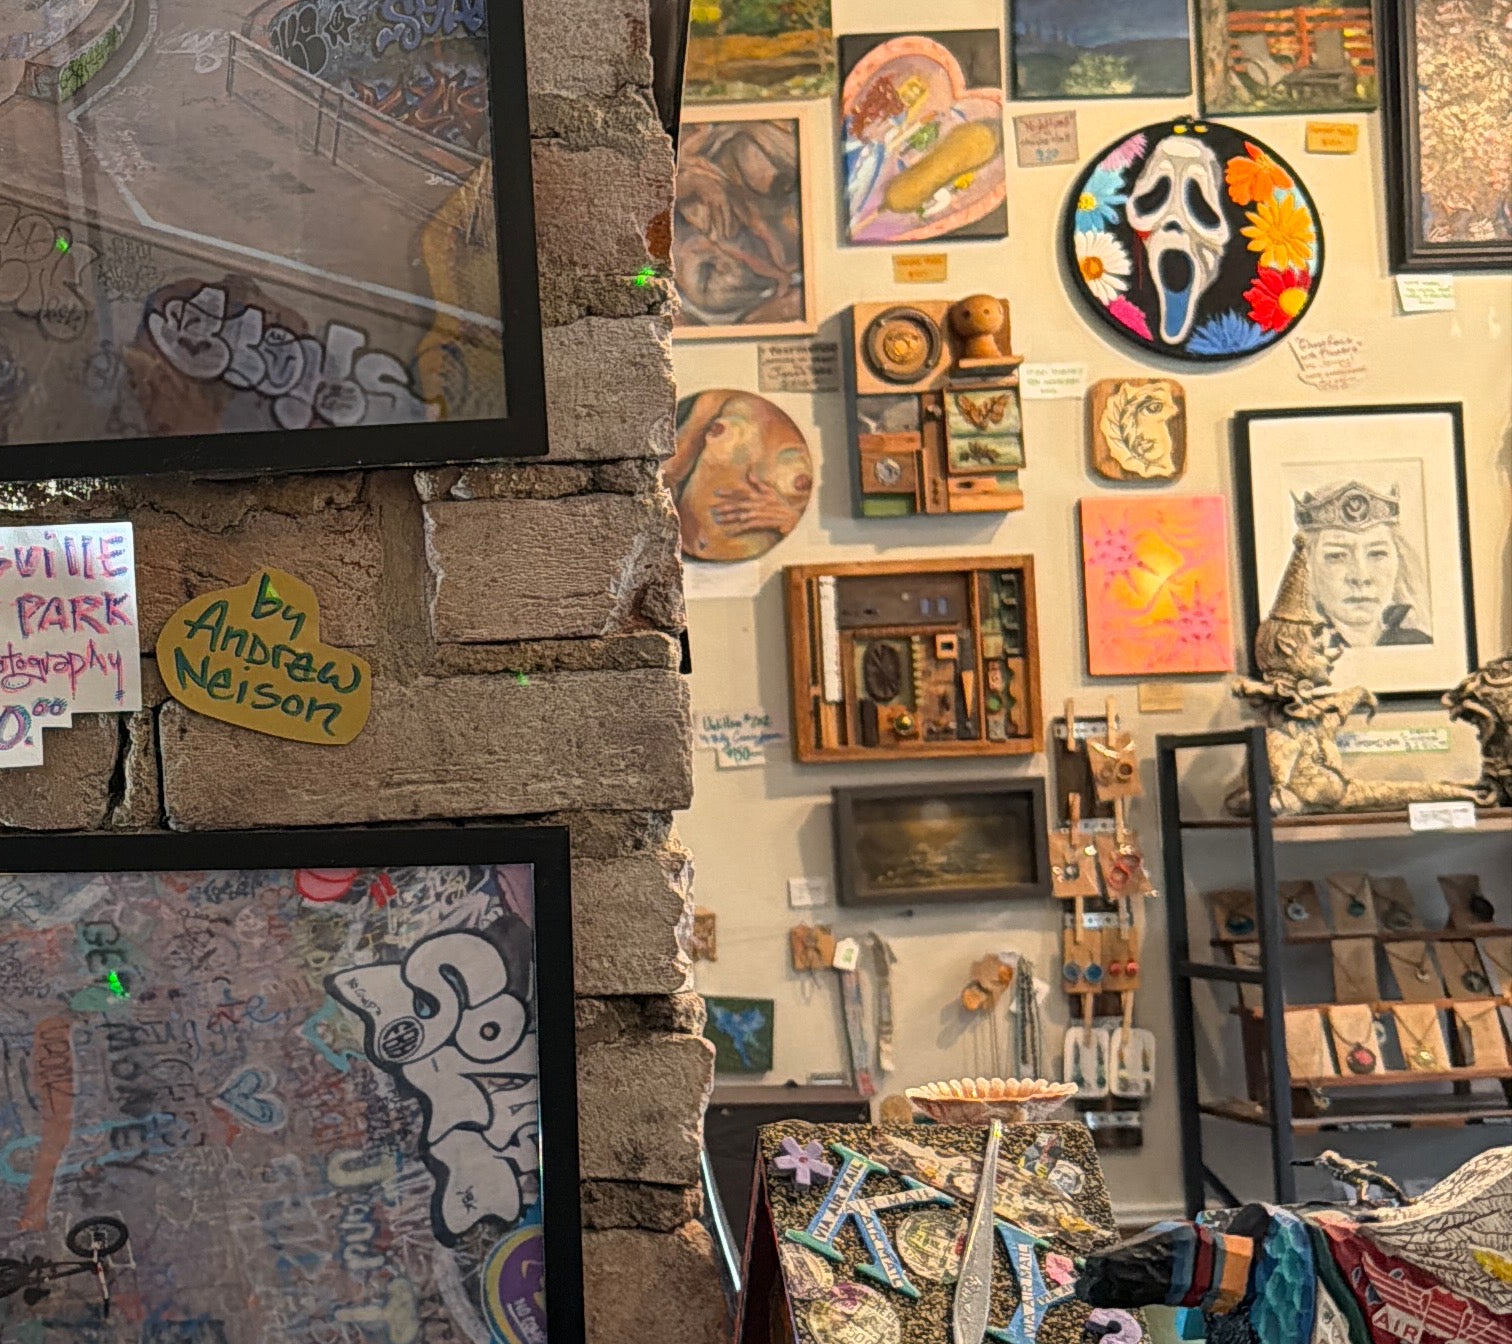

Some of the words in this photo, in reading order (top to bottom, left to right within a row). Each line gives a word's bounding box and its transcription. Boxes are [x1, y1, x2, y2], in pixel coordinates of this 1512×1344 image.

[18, 591, 135, 638] PARK
[252, 572, 307, 636] by
[840, 1161, 865, 1193] MAIL
[1373, 1312, 1420, 1342] AIR
